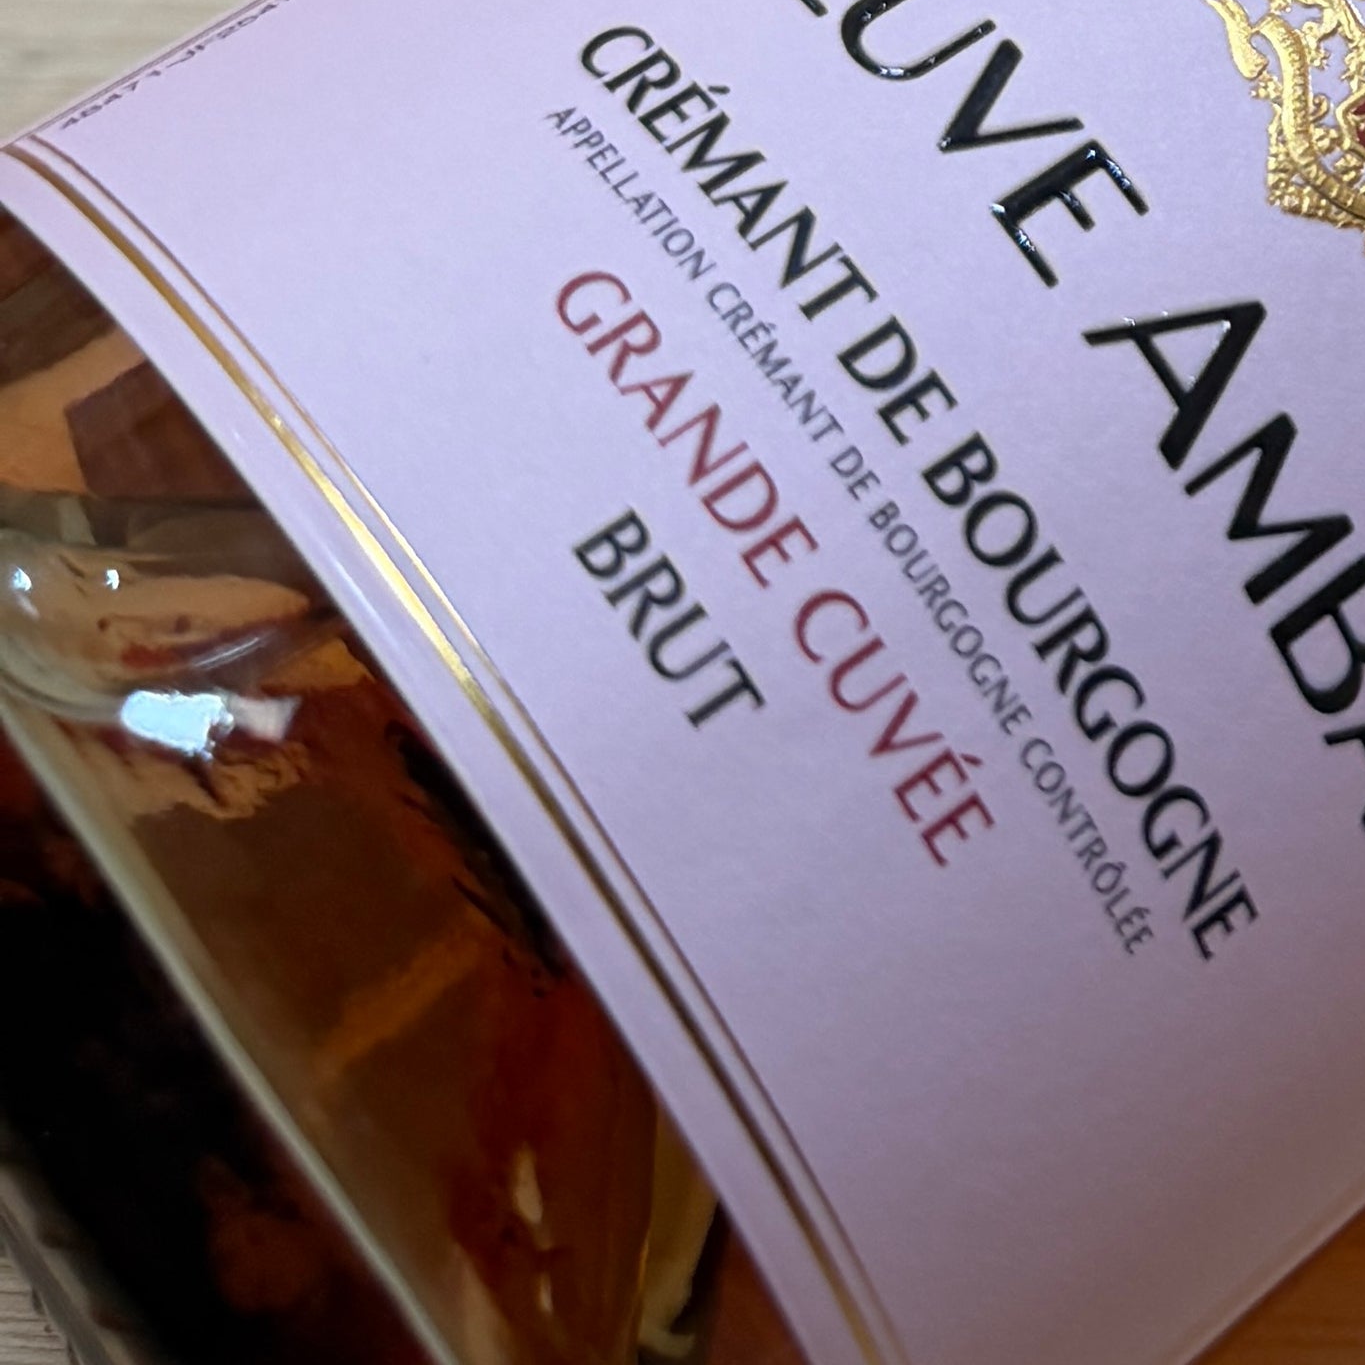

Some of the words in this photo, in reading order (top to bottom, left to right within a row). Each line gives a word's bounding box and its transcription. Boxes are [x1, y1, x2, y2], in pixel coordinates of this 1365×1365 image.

[544, 106, 717, 282] APPELLATION
[706, 281, 845, 443] CRÉMANT
[829, 445, 881, 501] DE
[868, 500, 1033, 736] BOURGOGNE
[1020, 736, 1156, 955] CONTRÔLÉE
[555, 270, 819, 590] GRANDE
[793, 589, 996, 868] CUVÉE
[571, 505, 768, 729] BRUT
[580, 25, 880, 322] CRÉMANT
[837, 314, 959, 446] DE
[922, 431, 1259, 960] BOURGOGNE
